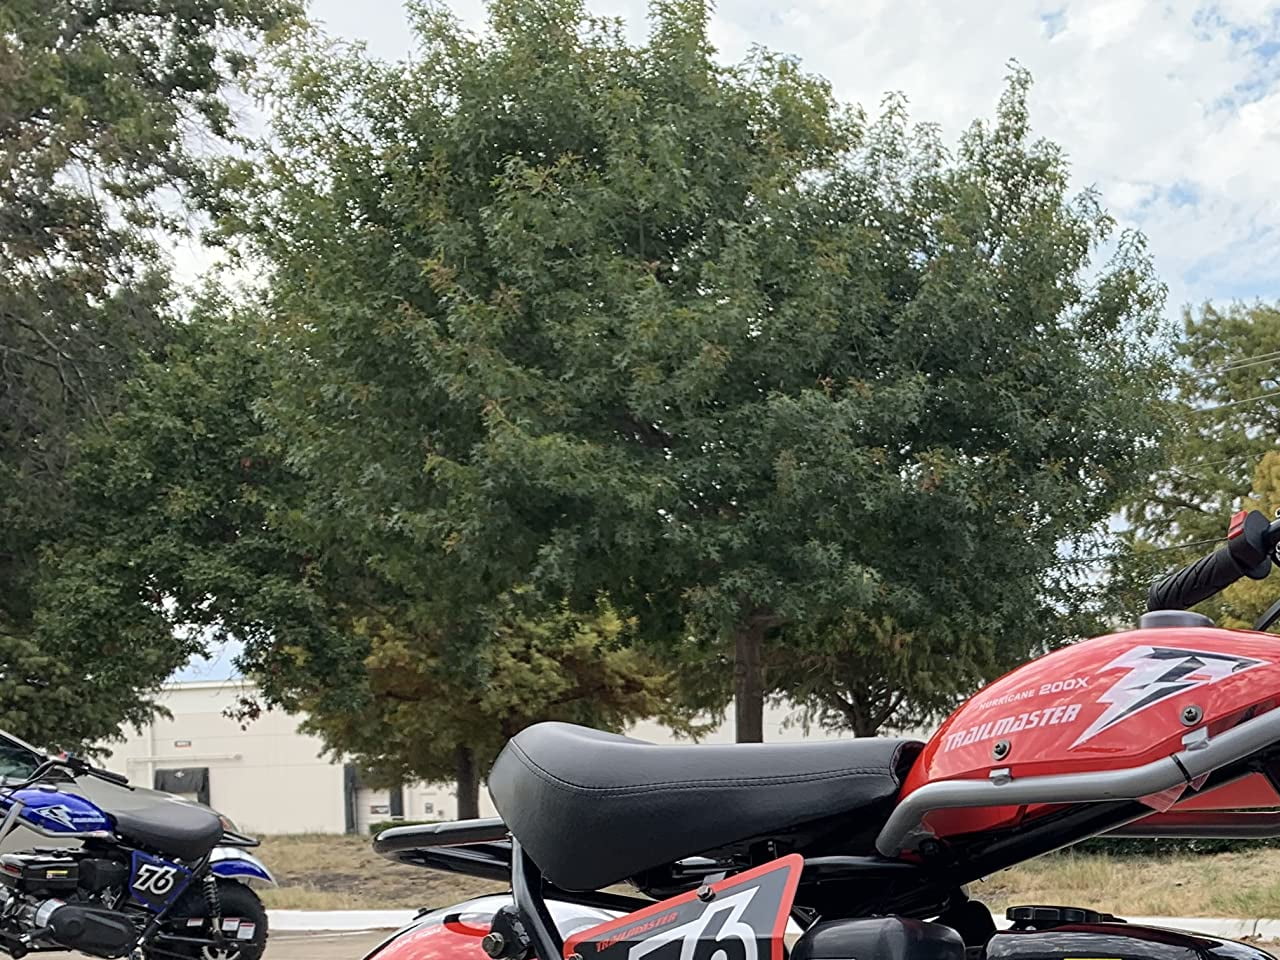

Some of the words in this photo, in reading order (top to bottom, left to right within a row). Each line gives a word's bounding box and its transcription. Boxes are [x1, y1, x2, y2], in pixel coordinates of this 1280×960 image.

[978, 689, 1035, 710] HURRICANE
[1039, 676, 1090, 696] 200X
[944, 703, 1082, 753] TRAILMASTER
[132, 863, 177, 895] 76
[595, 911, 678, 953] TRAILMASTER
